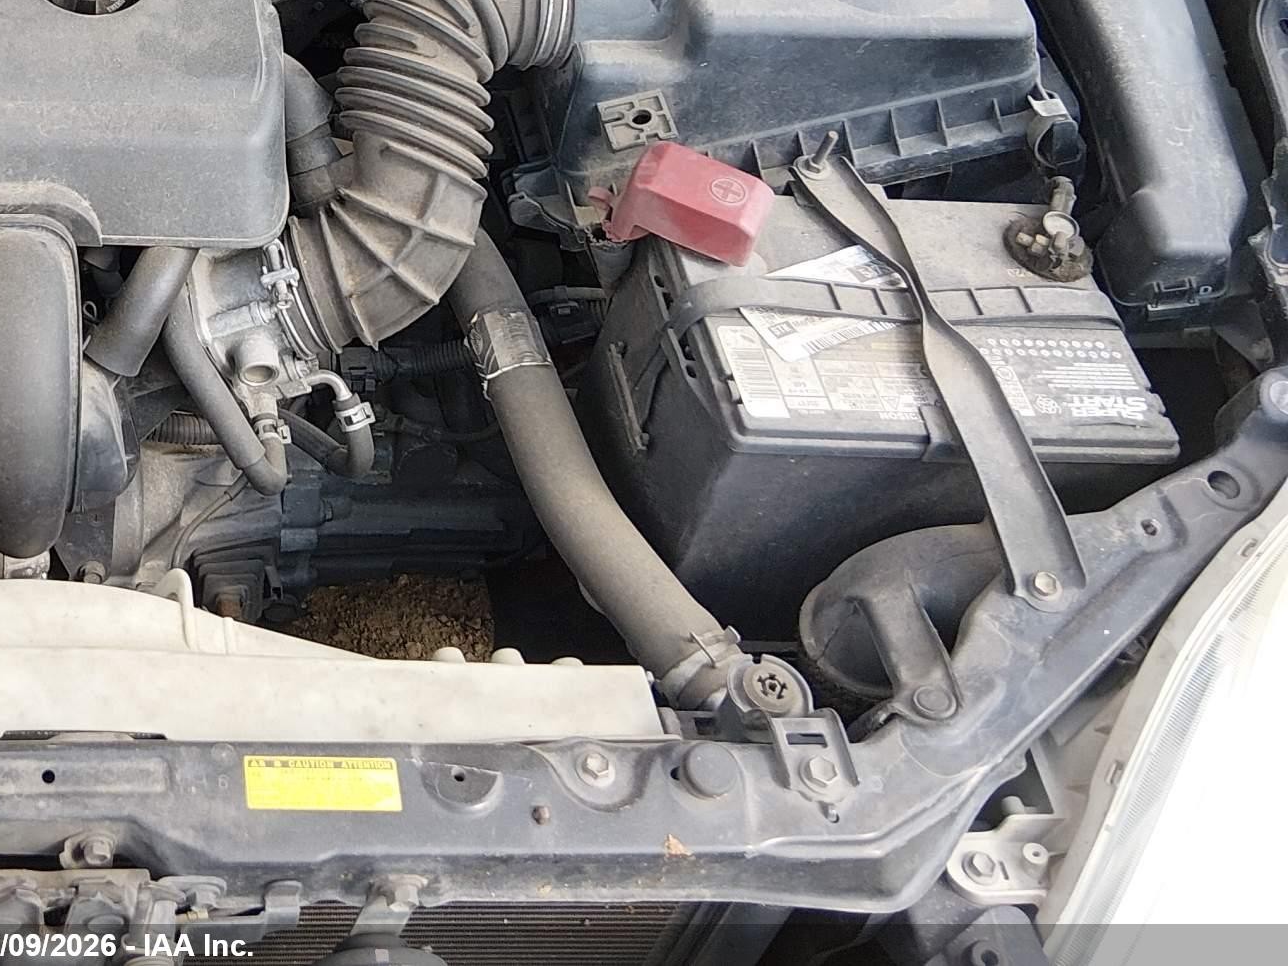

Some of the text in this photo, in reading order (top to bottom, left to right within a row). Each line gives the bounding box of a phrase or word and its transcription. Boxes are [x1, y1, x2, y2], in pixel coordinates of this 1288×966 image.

[1068, 395, 1148, 412] START
[1071, 406, 1145, 421] SUPER
[288, 760, 335, 769] CAUTION
[341, 761, 393, 770] ATTENTION
